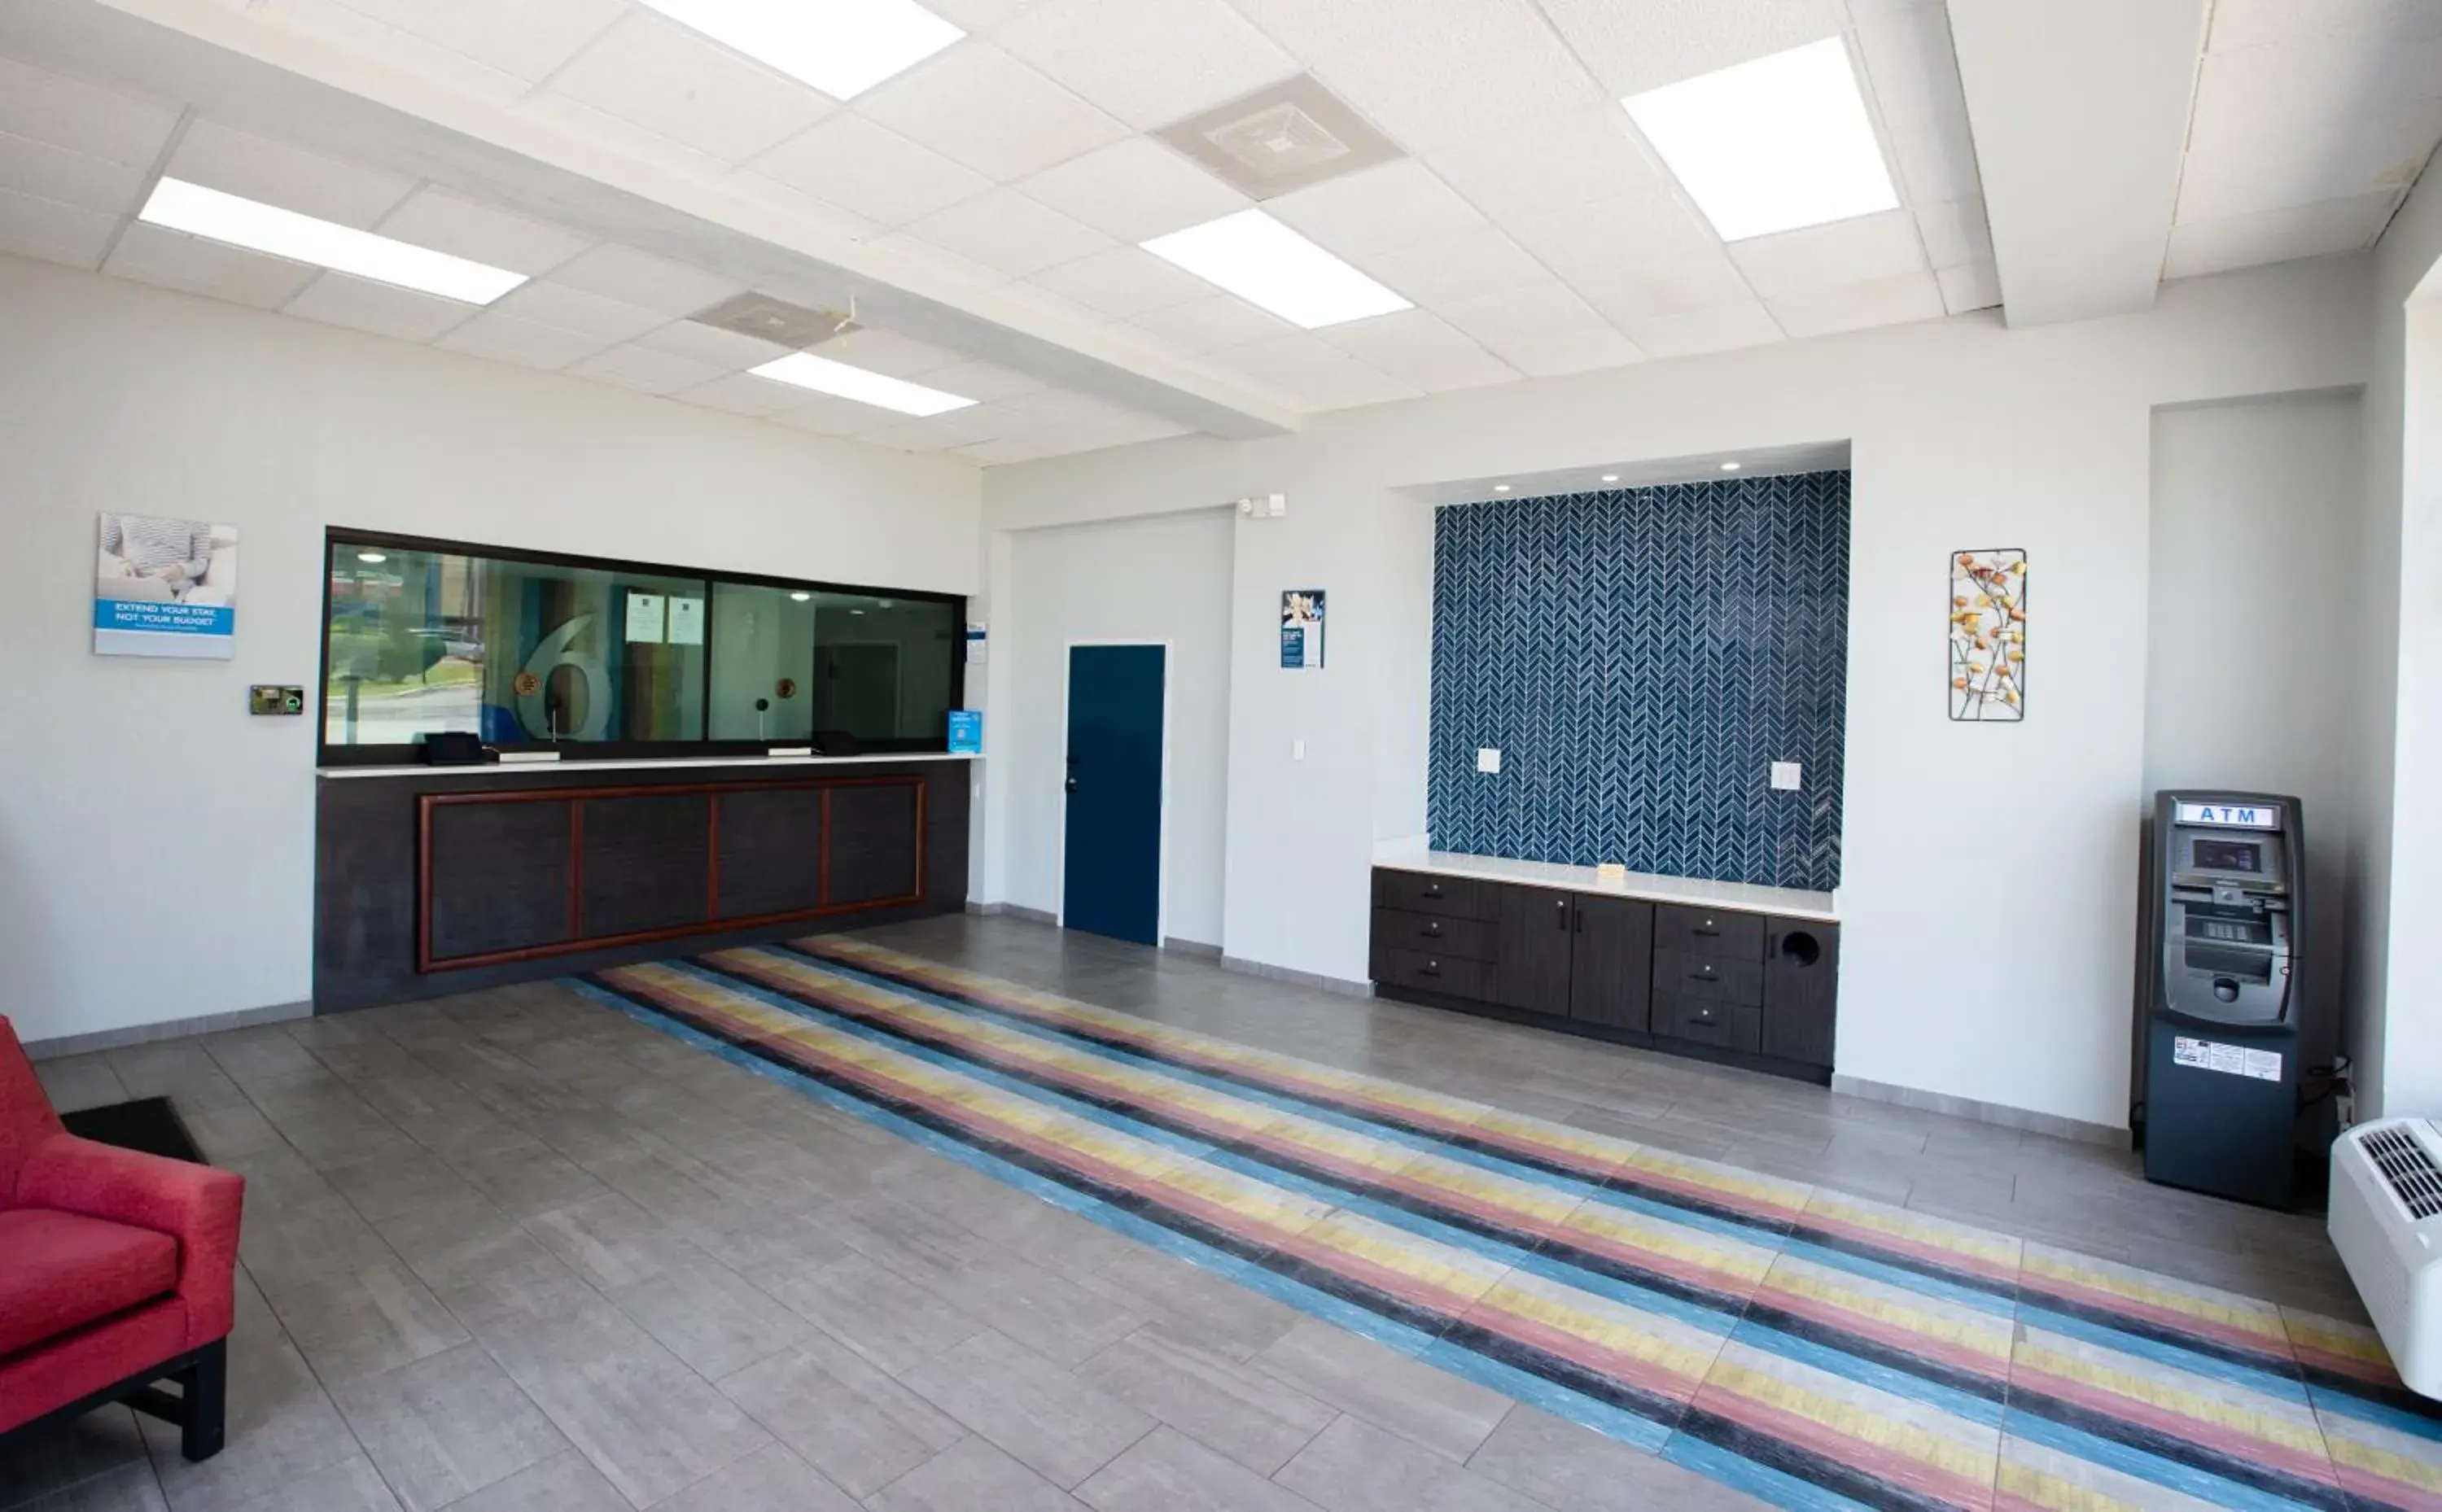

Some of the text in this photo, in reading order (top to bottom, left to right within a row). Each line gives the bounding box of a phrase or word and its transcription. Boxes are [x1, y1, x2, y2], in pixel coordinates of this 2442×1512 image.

[116, 603, 159, 613] EXTEND
[162, 606, 190, 614] YOUR
[116, 613, 212, 626] NOT YOUR BUDGET
[514, 612, 613, 741] 6
[2200, 806, 2255, 823] ATM
